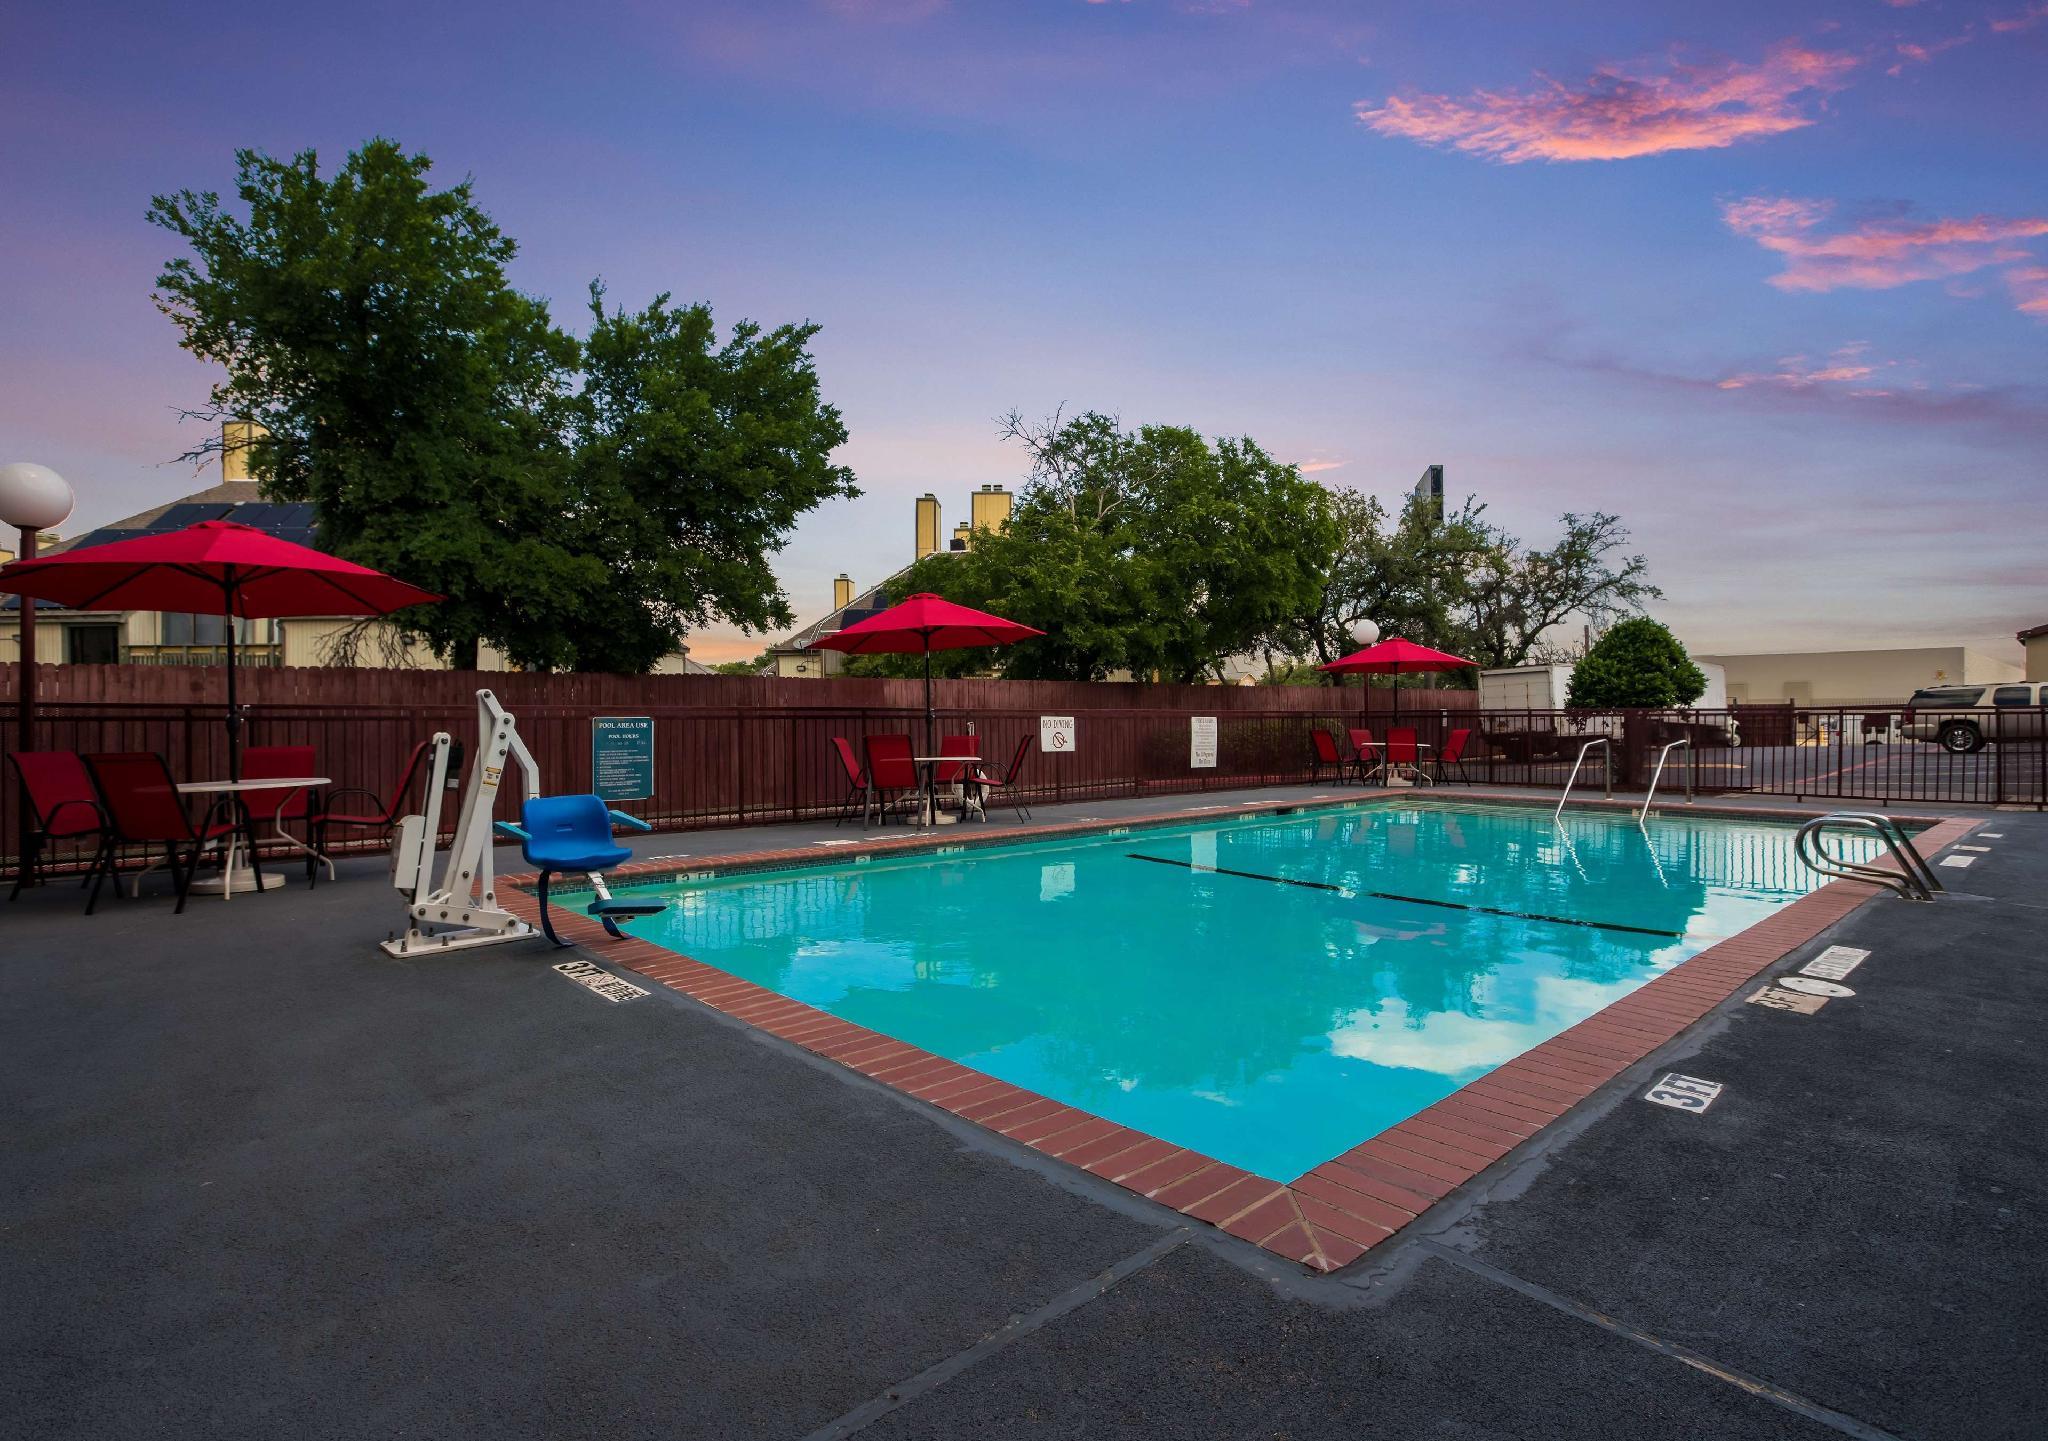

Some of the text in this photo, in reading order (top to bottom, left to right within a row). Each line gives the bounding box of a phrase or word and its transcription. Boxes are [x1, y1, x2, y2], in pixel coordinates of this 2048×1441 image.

[1042, 719, 1073, 729] NO DIVING
[559, 962, 590, 971] 3
[1651, 1073, 1718, 1108] 3 FT
